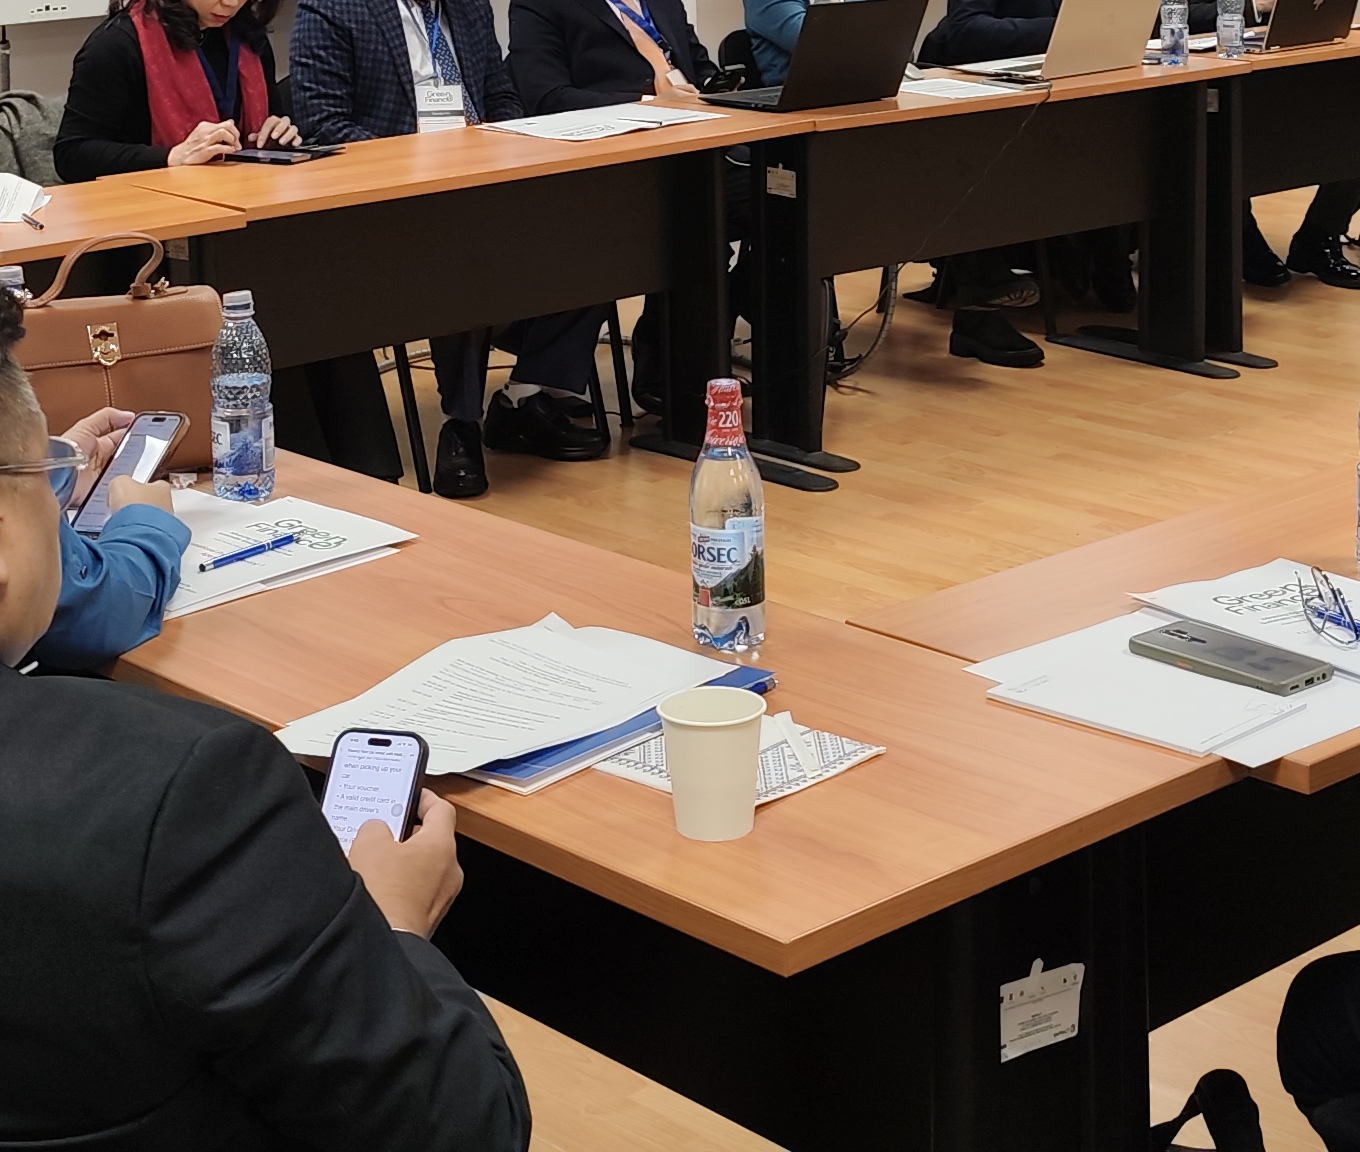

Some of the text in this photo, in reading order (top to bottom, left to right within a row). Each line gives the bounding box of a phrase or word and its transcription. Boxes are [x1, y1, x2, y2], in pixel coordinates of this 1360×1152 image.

[718, 410, 738, 428] 220
[274, 518, 347, 544] Green
[692, 542, 738, 564] ORSEC
[1212, 583, 1314, 606] Green
